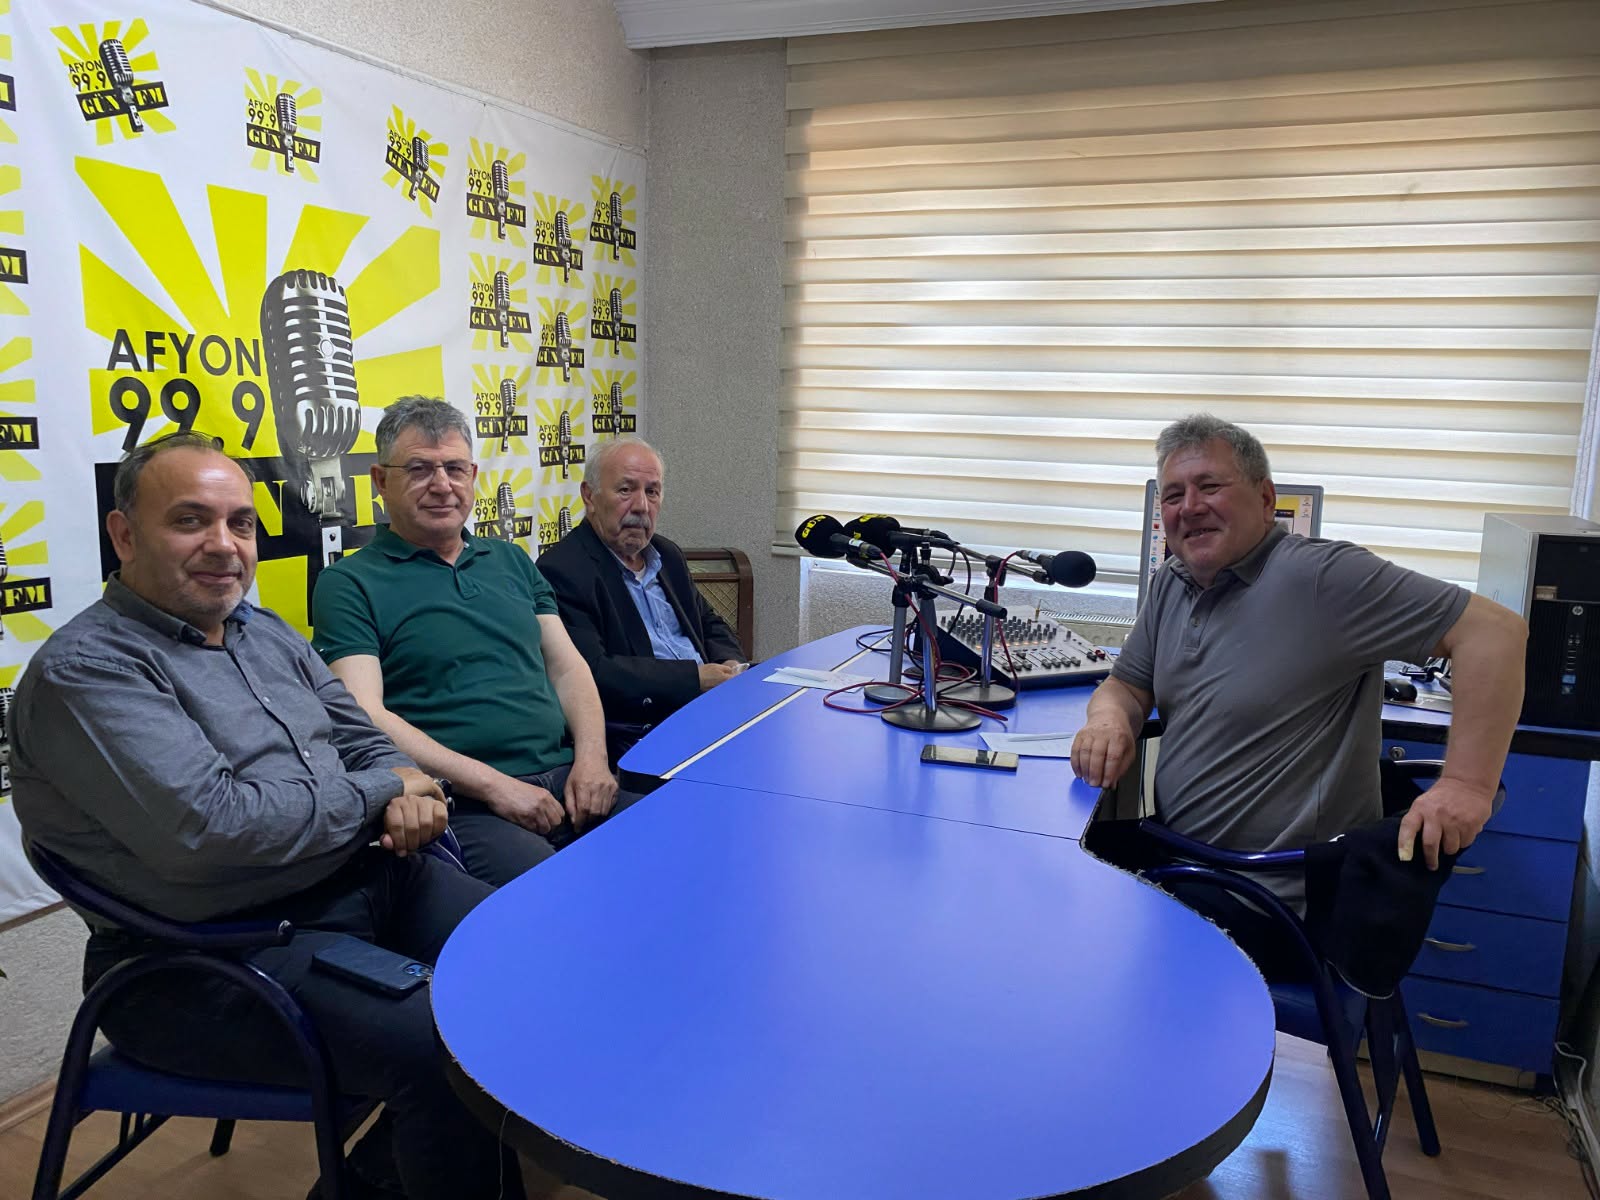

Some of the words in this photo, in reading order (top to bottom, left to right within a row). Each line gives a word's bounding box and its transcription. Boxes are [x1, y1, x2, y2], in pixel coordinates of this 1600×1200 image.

[68, 60, 104, 74] AFYON
[72, 71, 107, 92] 99.9
[81, 93, 121, 115] GÜN
[134, 87, 165, 106] FM
[248, 98, 277, 113] AFYON
[248, 108, 277, 128] 99.9
[248, 129, 283, 149] GÜN
[294, 140, 319, 158] FM
[389, 136, 412, 159] 99.9
[469, 168, 492, 181] AFYON
[468, 177, 493, 196] 99.9
[468, 197, 497, 216] GÜN
[506, 206, 525, 222] FM
[536, 220, 555, 231] AFYON
[535, 228, 555, 244] 99.9
[620, 231, 635, 246] FM
[534, 246, 560, 263] GÜN
[472, 282, 495, 293] AFYON
[472, 291, 495, 307] 99.9
[593, 298, 610, 307] AFYON
[471, 309, 497, 326] GÜN
[508, 315, 529, 329] FM
[593, 305, 610, 320] 99.9
[592, 321, 613, 337] GÜN
[620, 326, 635, 339] FM
[107, 328, 262, 377] AFYON
[476, 392, 502, 402] AFYON
[592, 393, 610, 402] AFYON
[476, 401, 502, 416] 99.9
[593, 401, 611, 414] 99.9
[478, 418, 504, 434] GÜN
[509, 419, 527, 432] FM
[539, 424, 560, 433] AFYON
[593, 416, 613, 430] GÜN
[621, 418, 635, 430] FM
[539, 433, 559, 446] 99.9
[569, 448, 584, 461] FM
[476, 498, 497, 507] AFYON
[475, 506, 497, 521] 99.9
[514, 520, 531, 534] FM
[540, 521, 558, 530] AFYON
[539, 528, 558, 543] 99.9
[4, 584, 48, 608] FM
